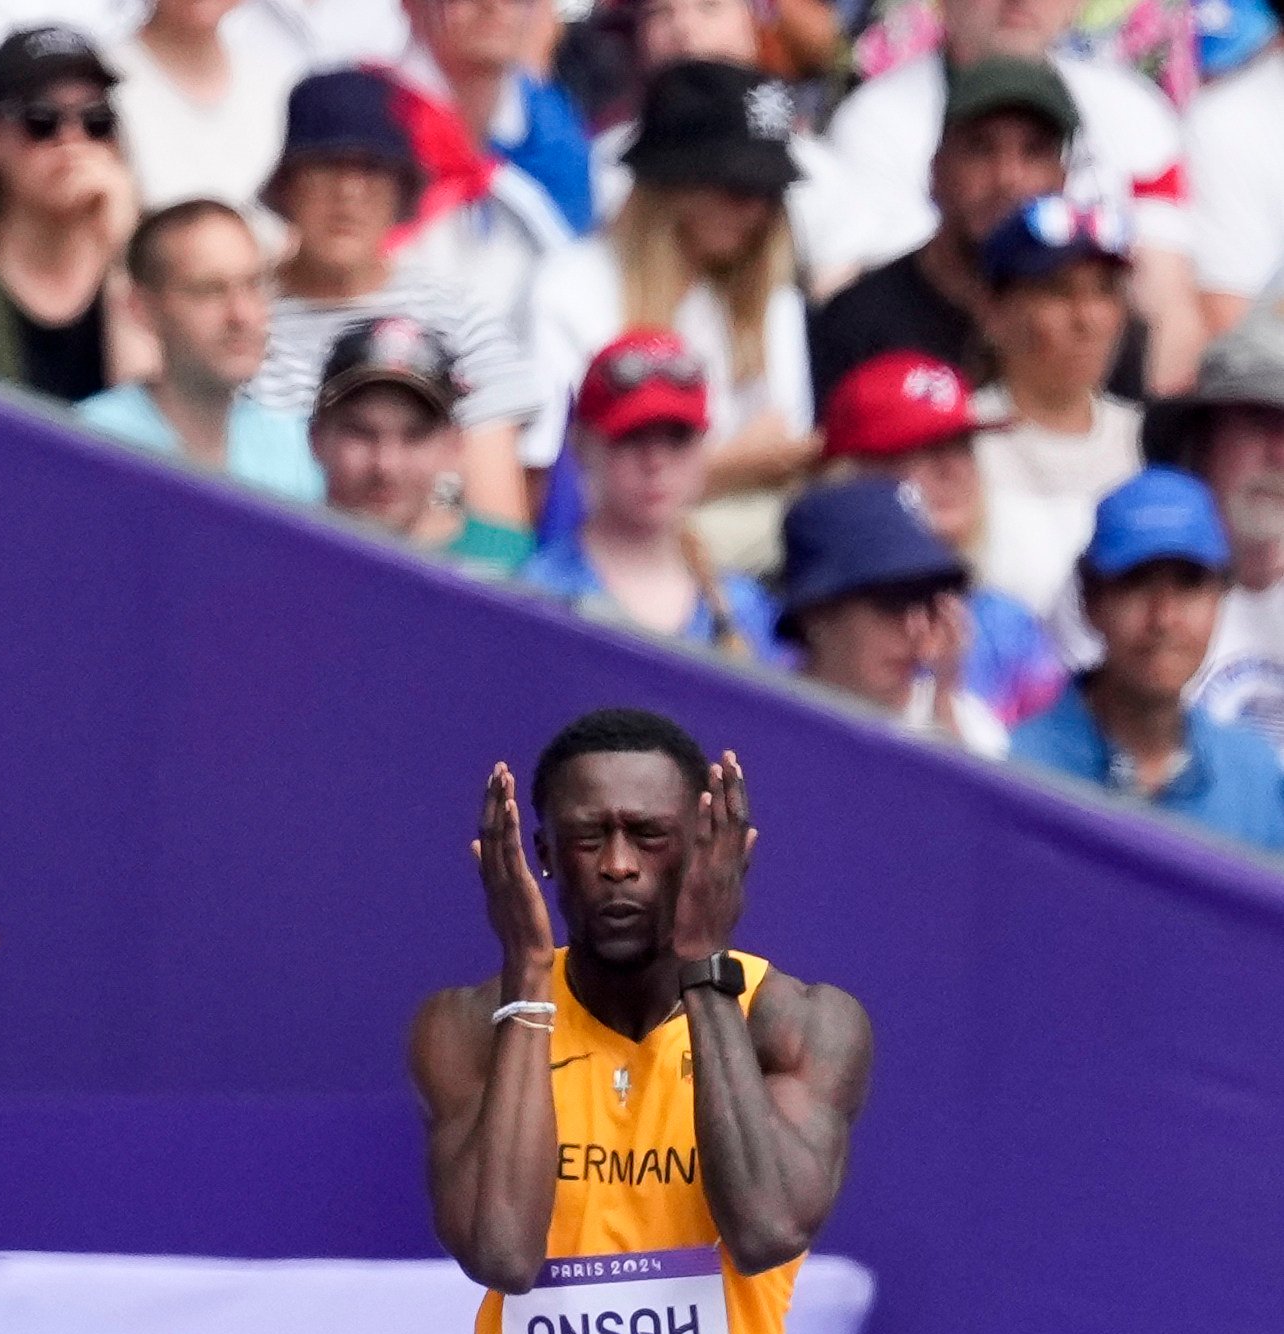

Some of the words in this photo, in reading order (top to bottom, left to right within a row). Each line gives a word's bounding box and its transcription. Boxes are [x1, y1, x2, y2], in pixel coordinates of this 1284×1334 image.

[556, 1143, 696, 1184] ERMAN
[551, 1263, 604, 1279] PARIS
[611, 1259, 662, 1275] 2024
